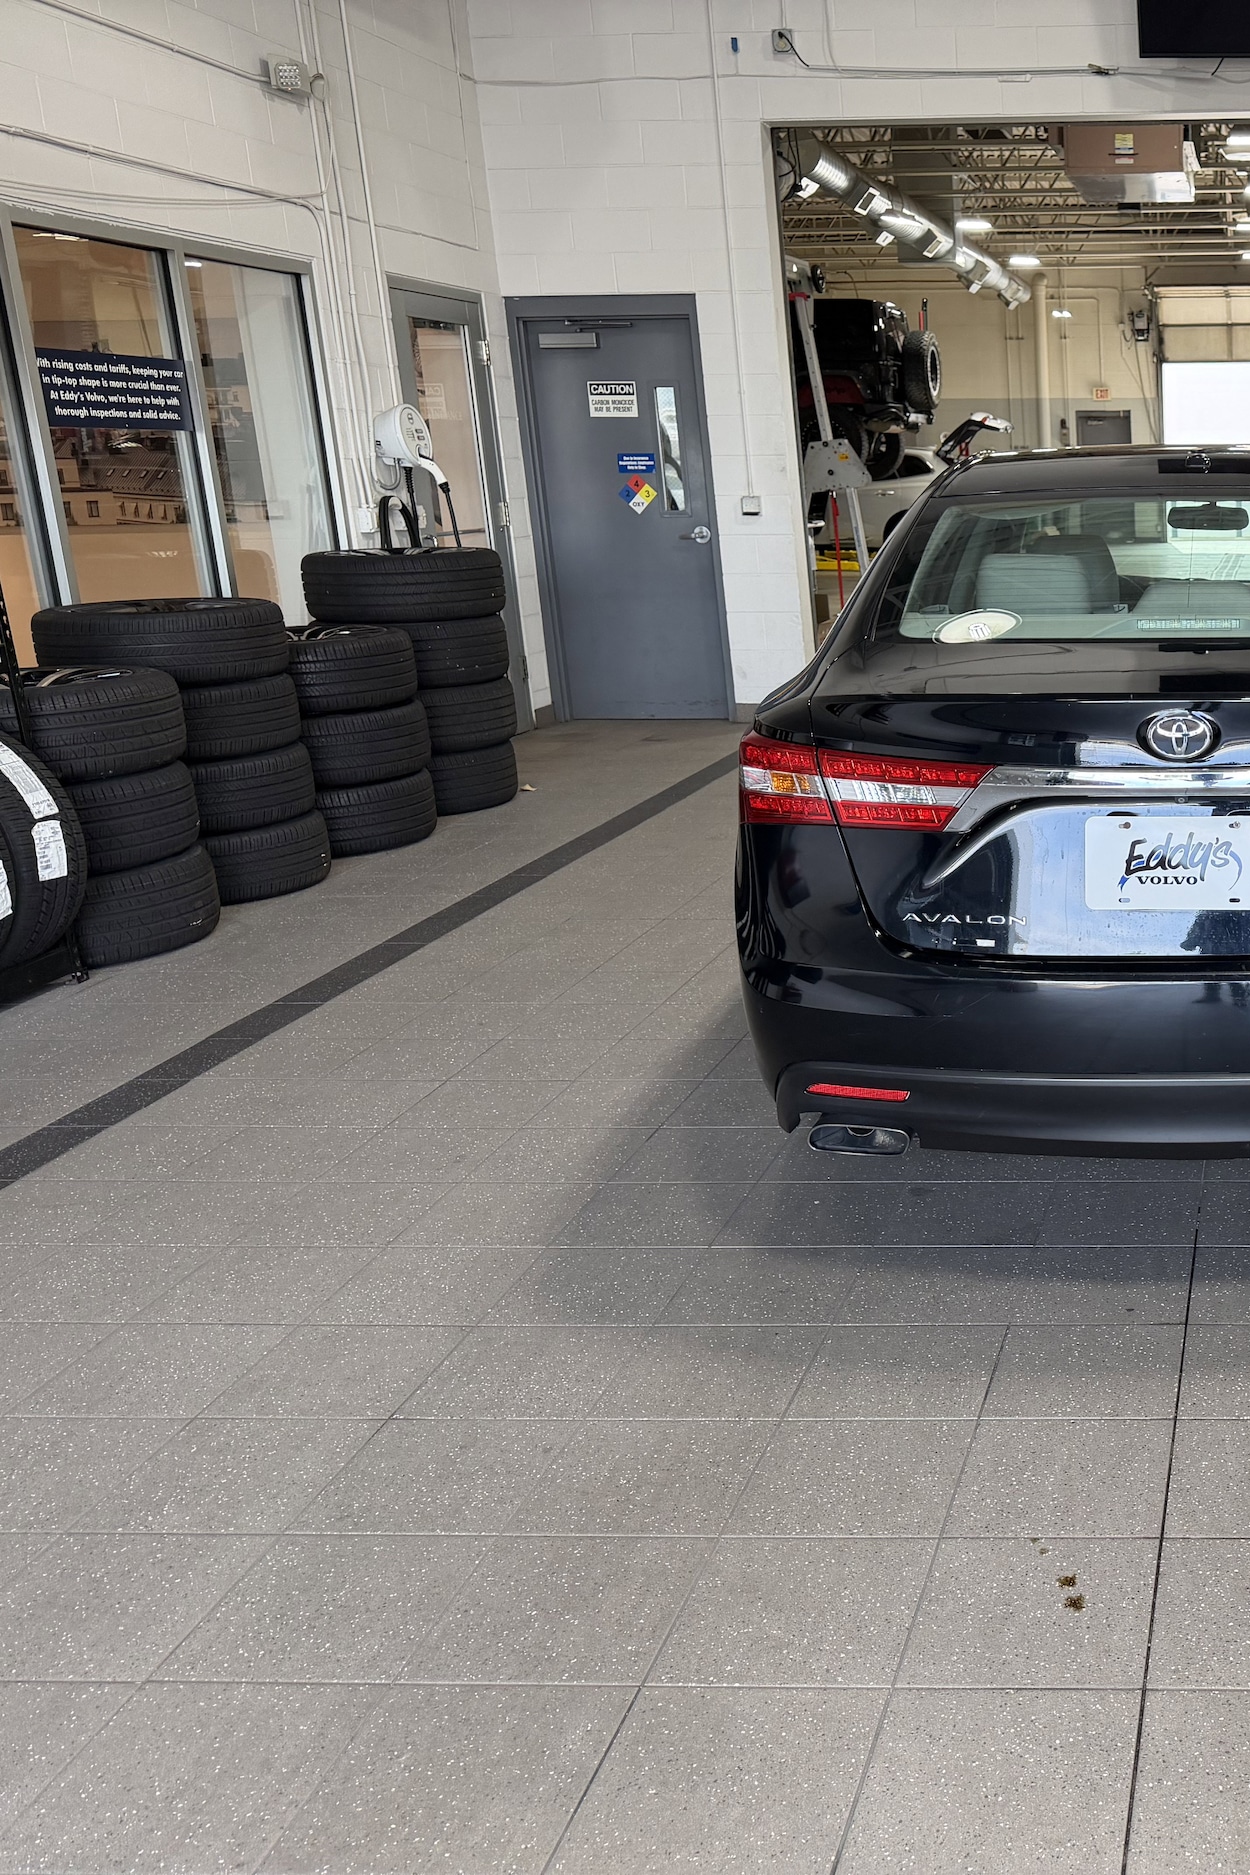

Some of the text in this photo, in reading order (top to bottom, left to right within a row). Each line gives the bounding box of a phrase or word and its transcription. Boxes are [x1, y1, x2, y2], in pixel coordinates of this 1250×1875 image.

[52, 358, 74, 372] rising
[75, 362, 93, 371] costs
[94, 362, 109, 372] and
[108, 364, 132, 376] tariffs,
[132, 364, 159, 379] keeping
[159, 370, 173, 379] your
[42, 373, 51, 384] in
[52, 374, 78, 388] tip-top
[78, 376, 101, 389] shape
[101, 377, 109, 387] is
[109, 380, 127, 389] more
[128, 380, 150, 390] crucial
[150, 381, 166, 391] than
[590, 384, 634, 394] CAUTION
[50, 390, 180, 408] At Eddy's Volvo, we're here to help with
[54, 405, 181, 420] thorough inspections and solid advice.
[634, 480, 640, 488] 4
[626, 490, 631, 498] 2
[644, 490, 650, 498] 3
[1124, 831, 1233, 882] Eddy's
[1136, 876, 1198, 885] VOLVO
[902, 912, 1026, 926] AVALON
